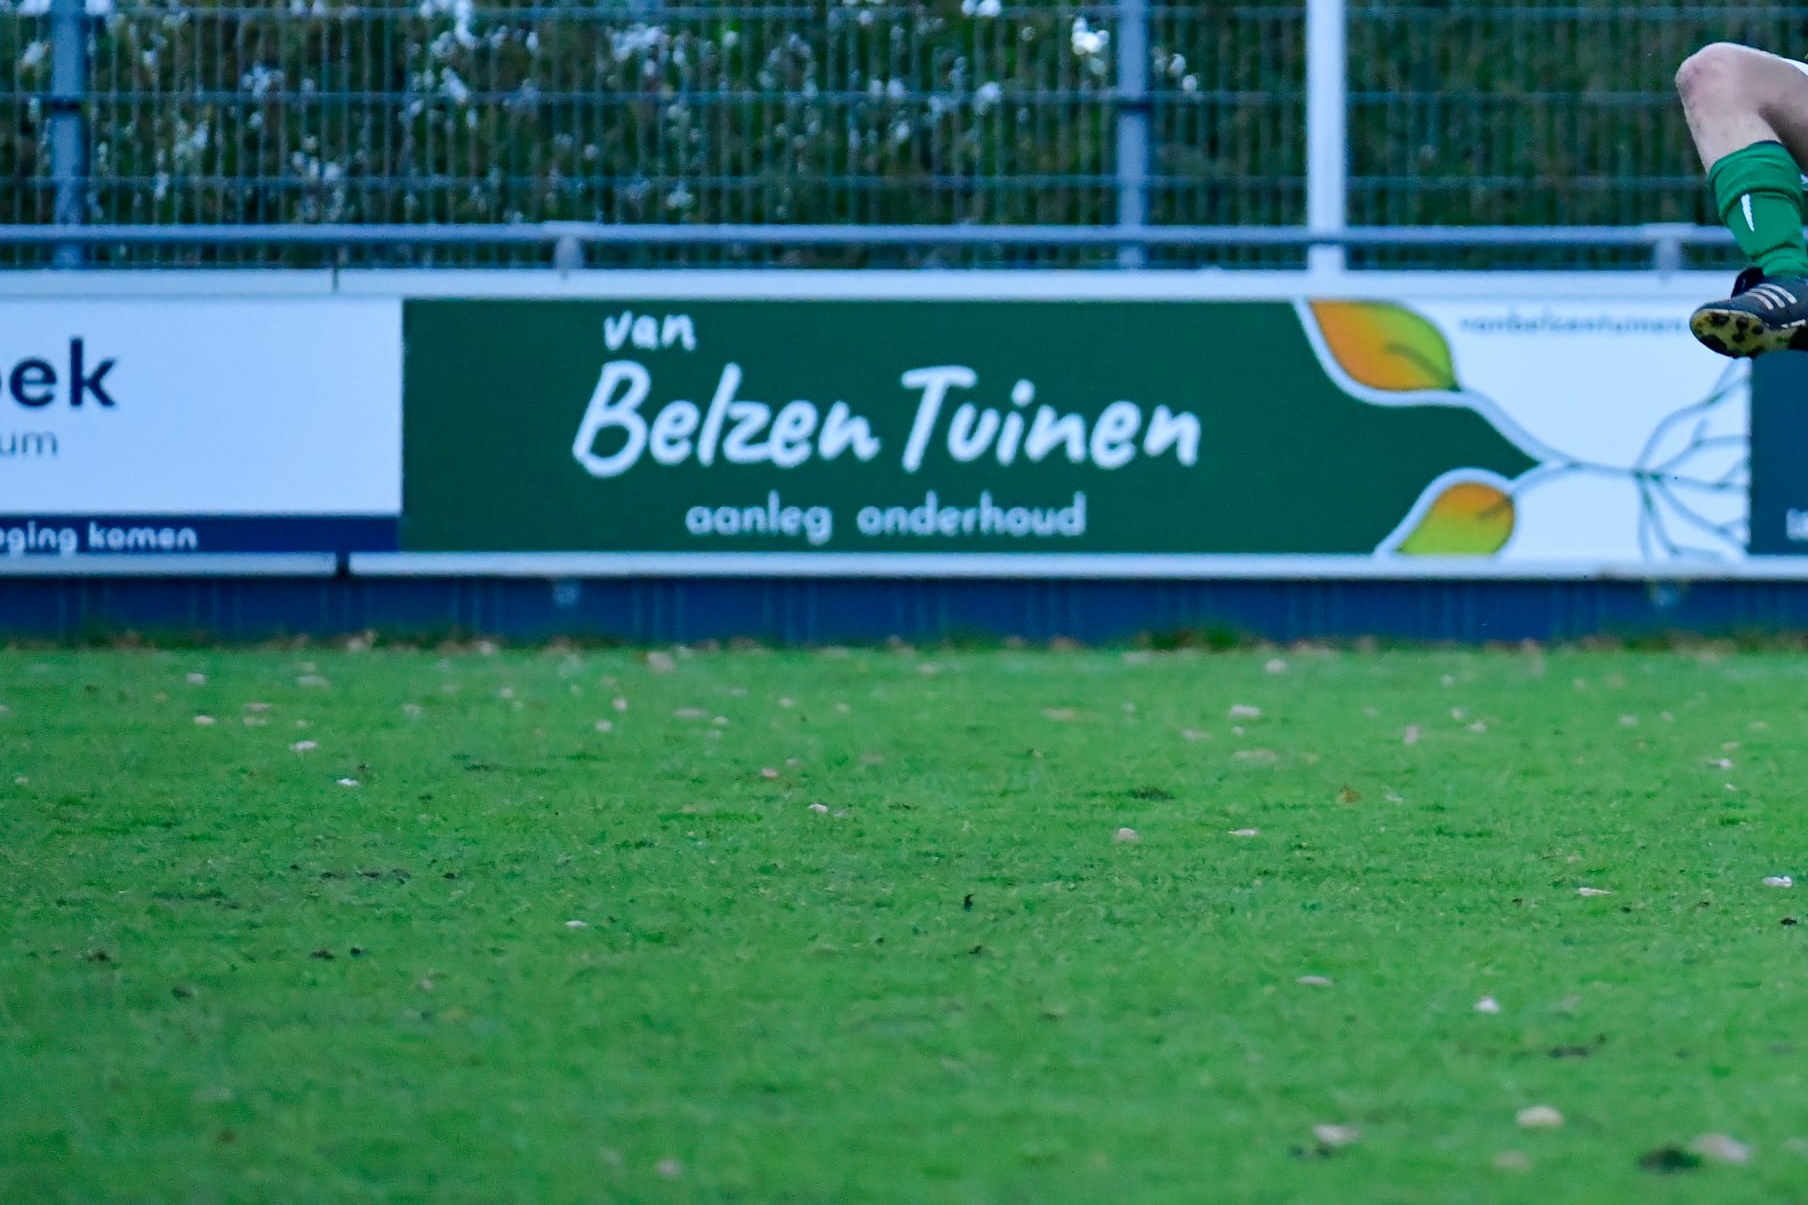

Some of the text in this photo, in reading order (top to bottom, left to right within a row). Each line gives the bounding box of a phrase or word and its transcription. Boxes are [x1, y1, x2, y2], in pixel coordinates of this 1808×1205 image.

[604, 310, 696, 350] van
[0, 337, 116, 408] ek
[573, 360, 1199, 477] Belzen Tuinen
[0, 521, 198, 556] ging komen
[686, 491, 1086, 545] aanleg onderhoud
